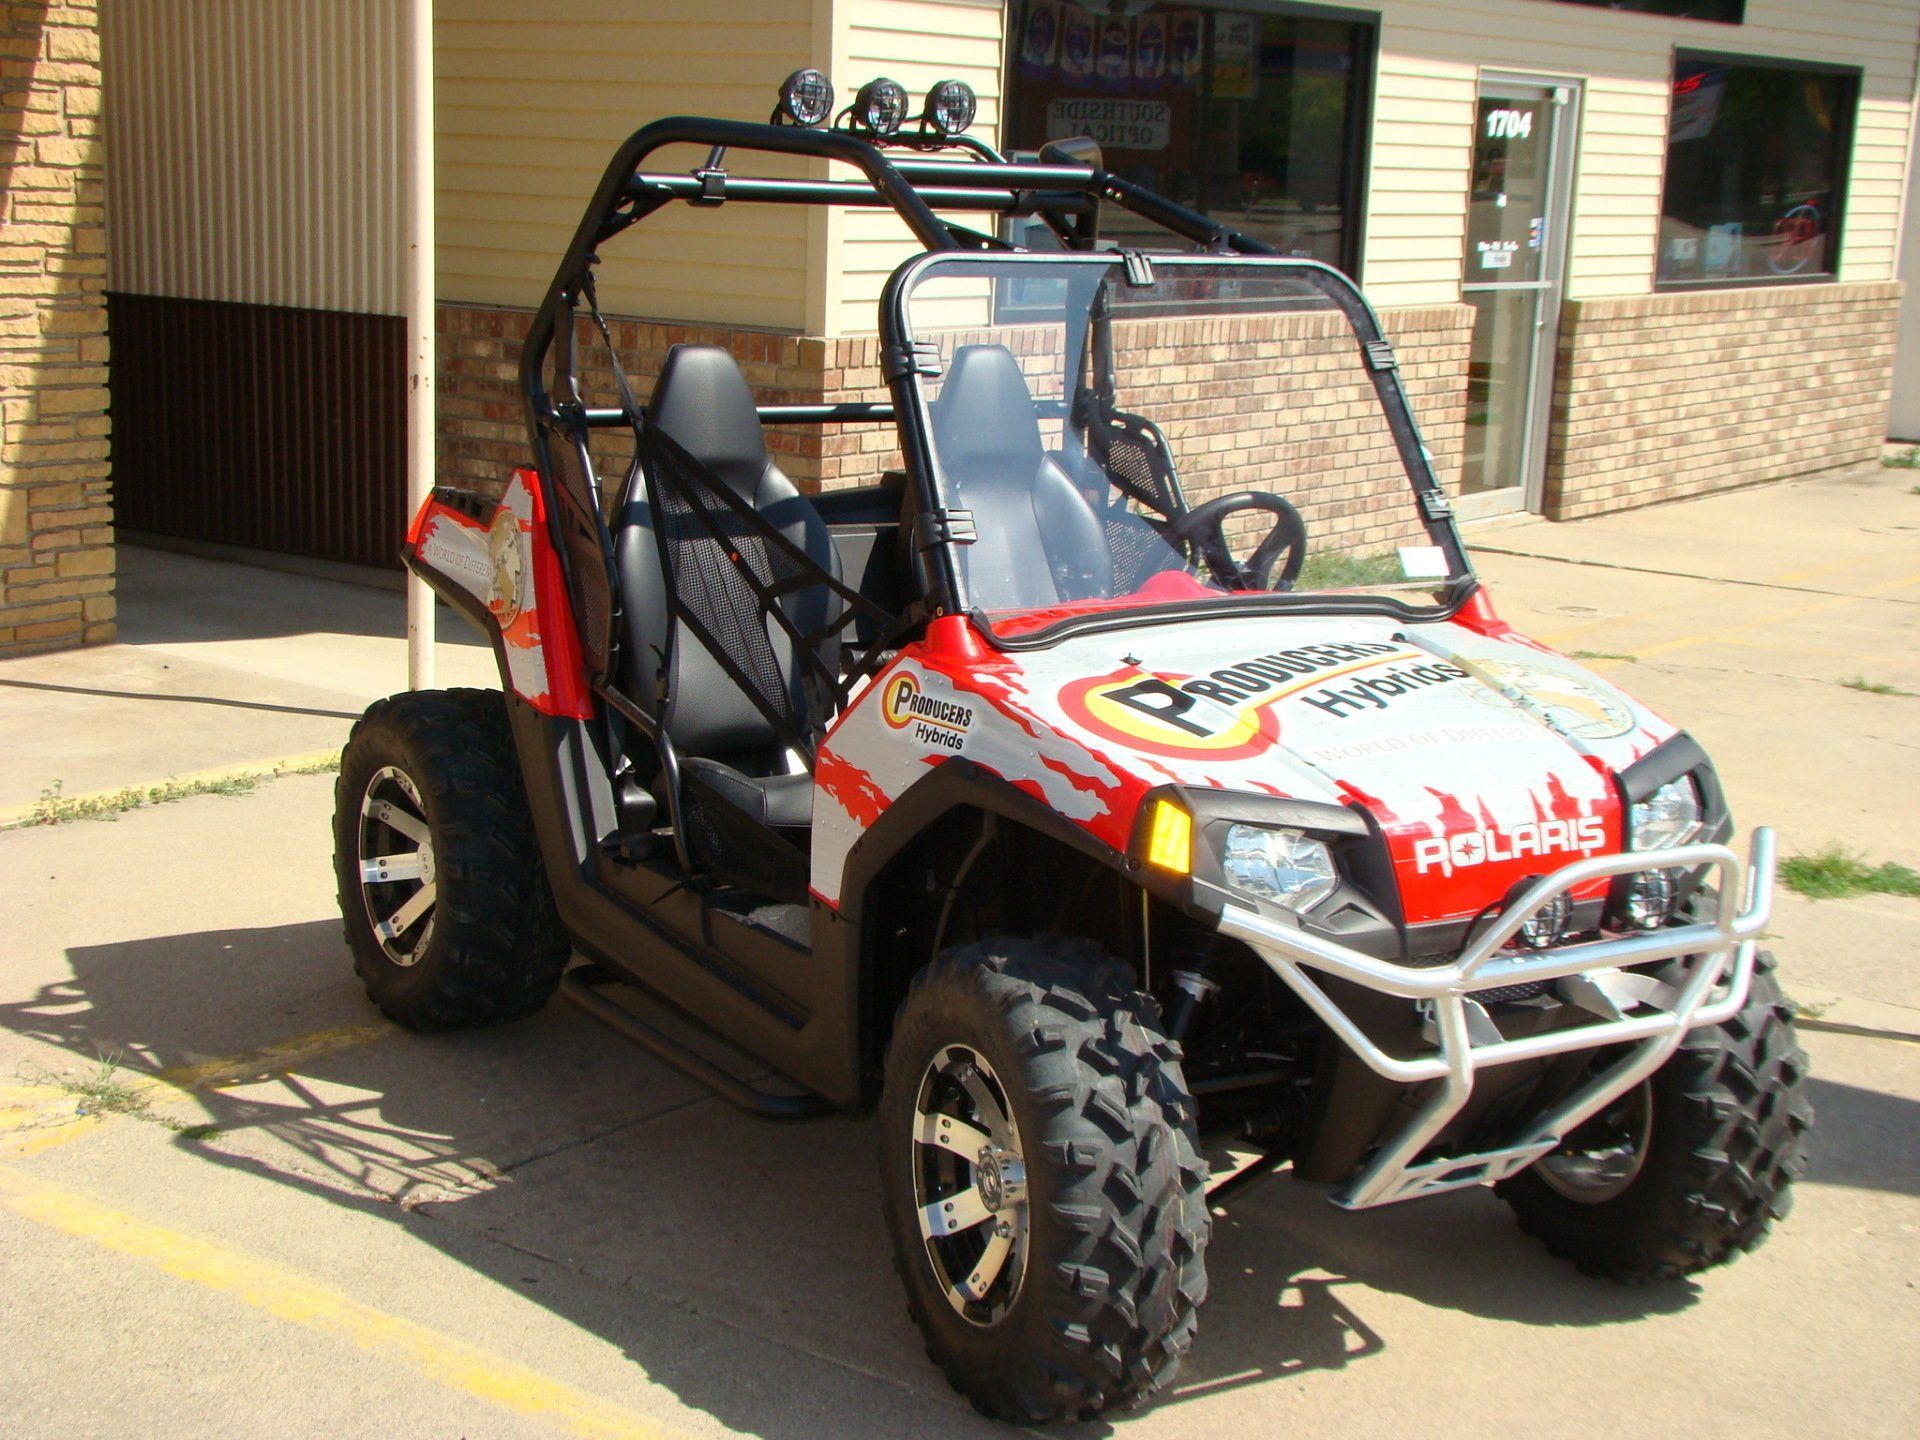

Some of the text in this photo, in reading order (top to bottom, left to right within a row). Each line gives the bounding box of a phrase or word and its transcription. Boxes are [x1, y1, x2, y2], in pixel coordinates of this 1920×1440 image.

[1487, 109, 1532, 138] 1704
[893, 680, 972, 727] PRODUCERS
[1301, 662, 1472, 719] Hybrids
[915, 722, 964, 750] Hybrids
[1313, 736, 1406, 762] WORLD
[1414, 816, 1605, 874] POLARIS
